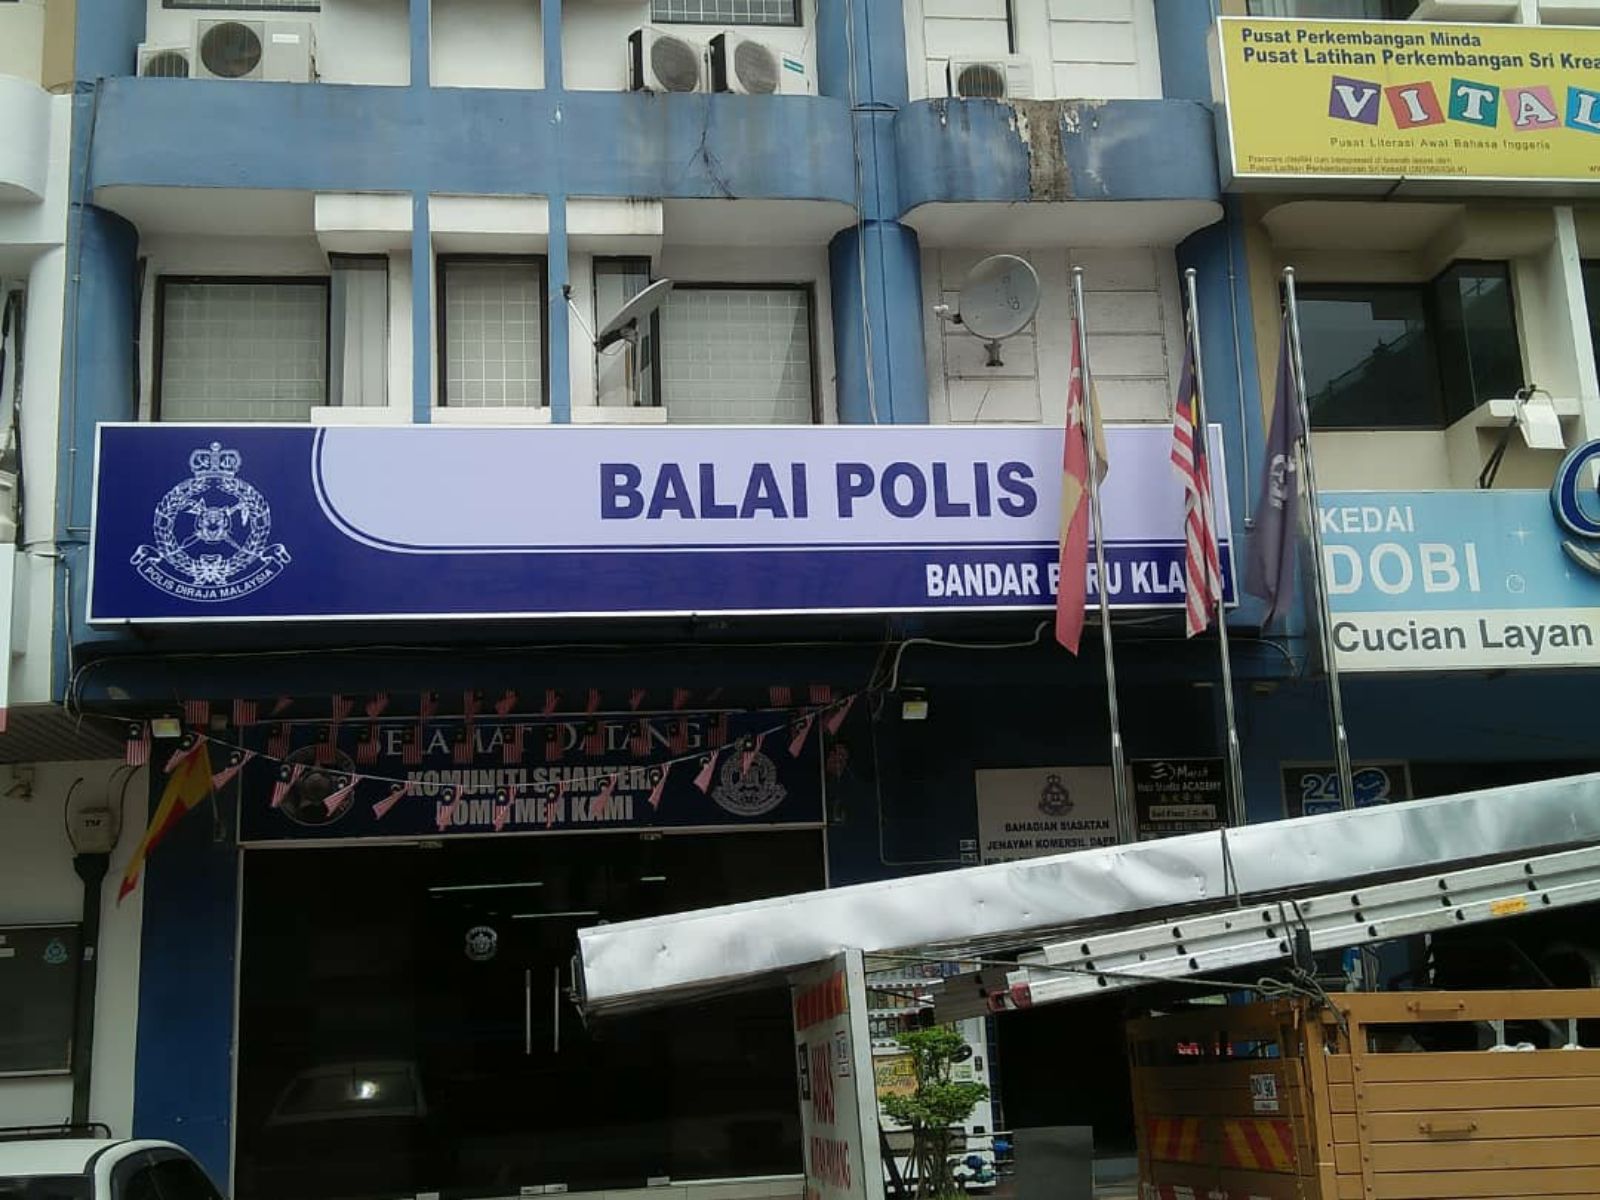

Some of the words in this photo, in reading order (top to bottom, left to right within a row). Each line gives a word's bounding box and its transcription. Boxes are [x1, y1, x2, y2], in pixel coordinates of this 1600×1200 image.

[1242, 28, 1291, 43] Pusat
[1297, 29, 1425, 49] Perkembangan
[1431, 32, 1481, 47] Minda
[1244, 47, 1298, 63] Pusat
[1304, 48, 1376, 65] Latihan
[1382, 49, 1523, 70] Perkembangan
[1529, 52, 1555, 68] Sri
[1330, 137, 1364, 148] Pusat
[1370, 137, 1415, 149] Literasi
[1420, 138, 1449, 149] Awal
[1454, 139, 1498, 150] Bahasa
[1503, 139, 1550, 151] Inggeris
[599, 462, 809, 520] BALAI
[835, 460, 1038, 519] POLIS
[1319, 506, 1415, 534] KEDAI
[144, 565, 174, 591] POLIS
[175, 582, 218, 599] DIRAJA
[220, 567, 274, 598] MALAYSIA
[925, 562, 1041, 598] BANDAR
[1048, 561, 1122, 596] BRU
[1131, 560, 1226, 595] KLA
[1323, 542, 1481, 595] DOBI
[1333, 619, 1466, 653] Cucian
[1479, 618, 1593, 656] Layan
[407, 768, 527, 797] KOMUNITI
